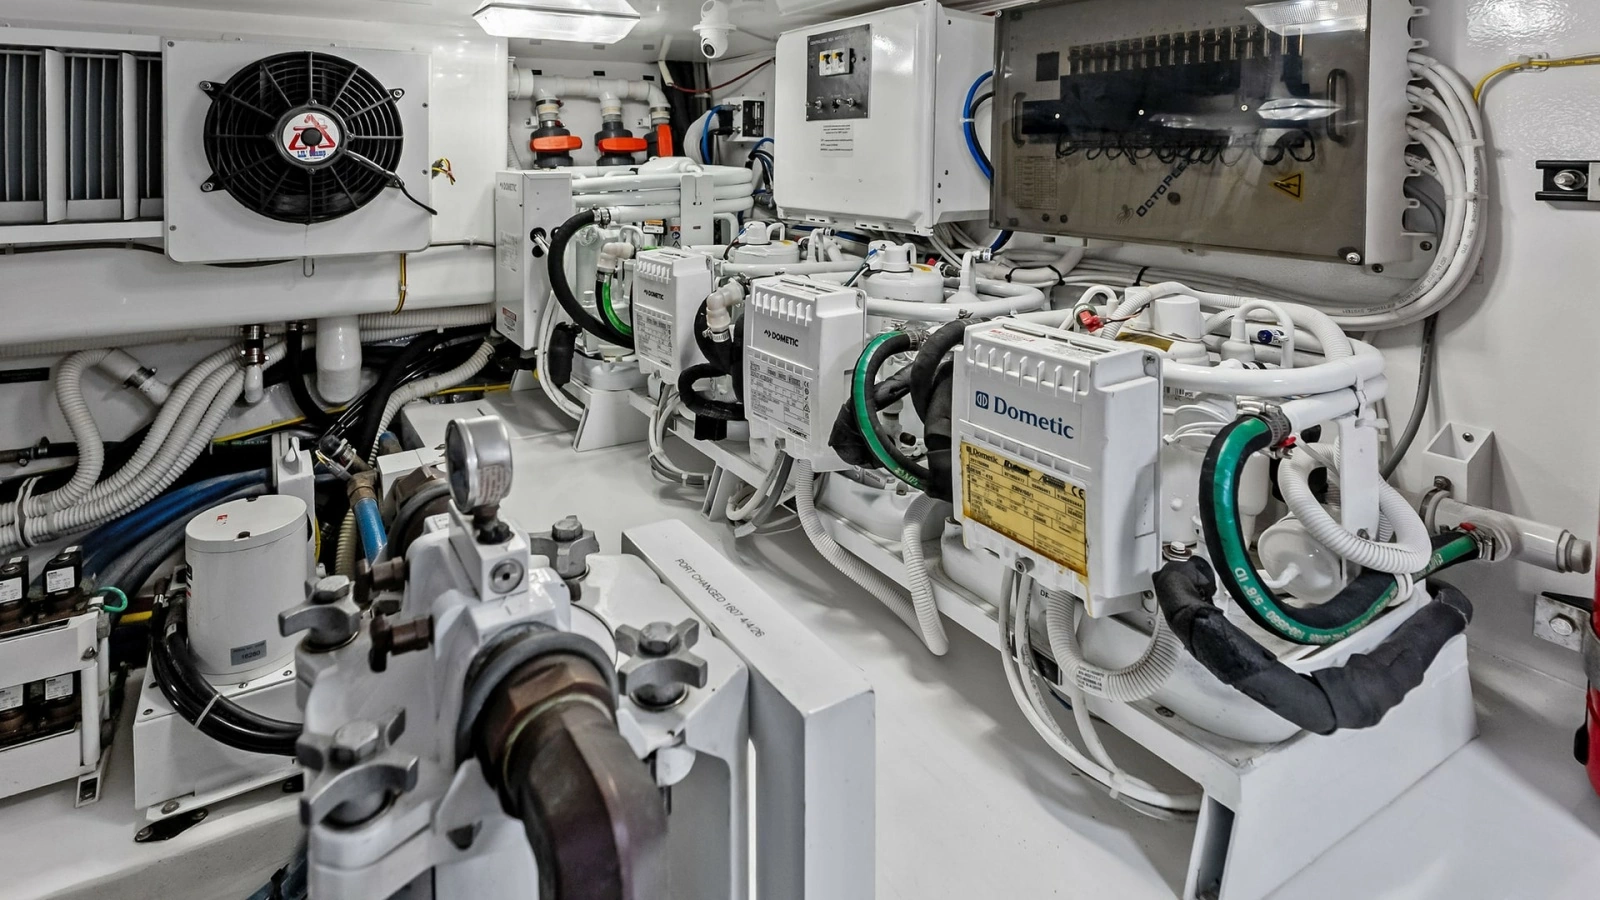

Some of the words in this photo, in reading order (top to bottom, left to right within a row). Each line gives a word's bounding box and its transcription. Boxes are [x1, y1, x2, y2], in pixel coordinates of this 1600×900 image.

[771, 332, 799, 347] DOMETIC
[994, 395, 1075, 440] Dometic
[675, 558, 696, 575] PORT
[692, 572, 726, 603] CHANGED
[1234, 567, 1249, 583] ID
